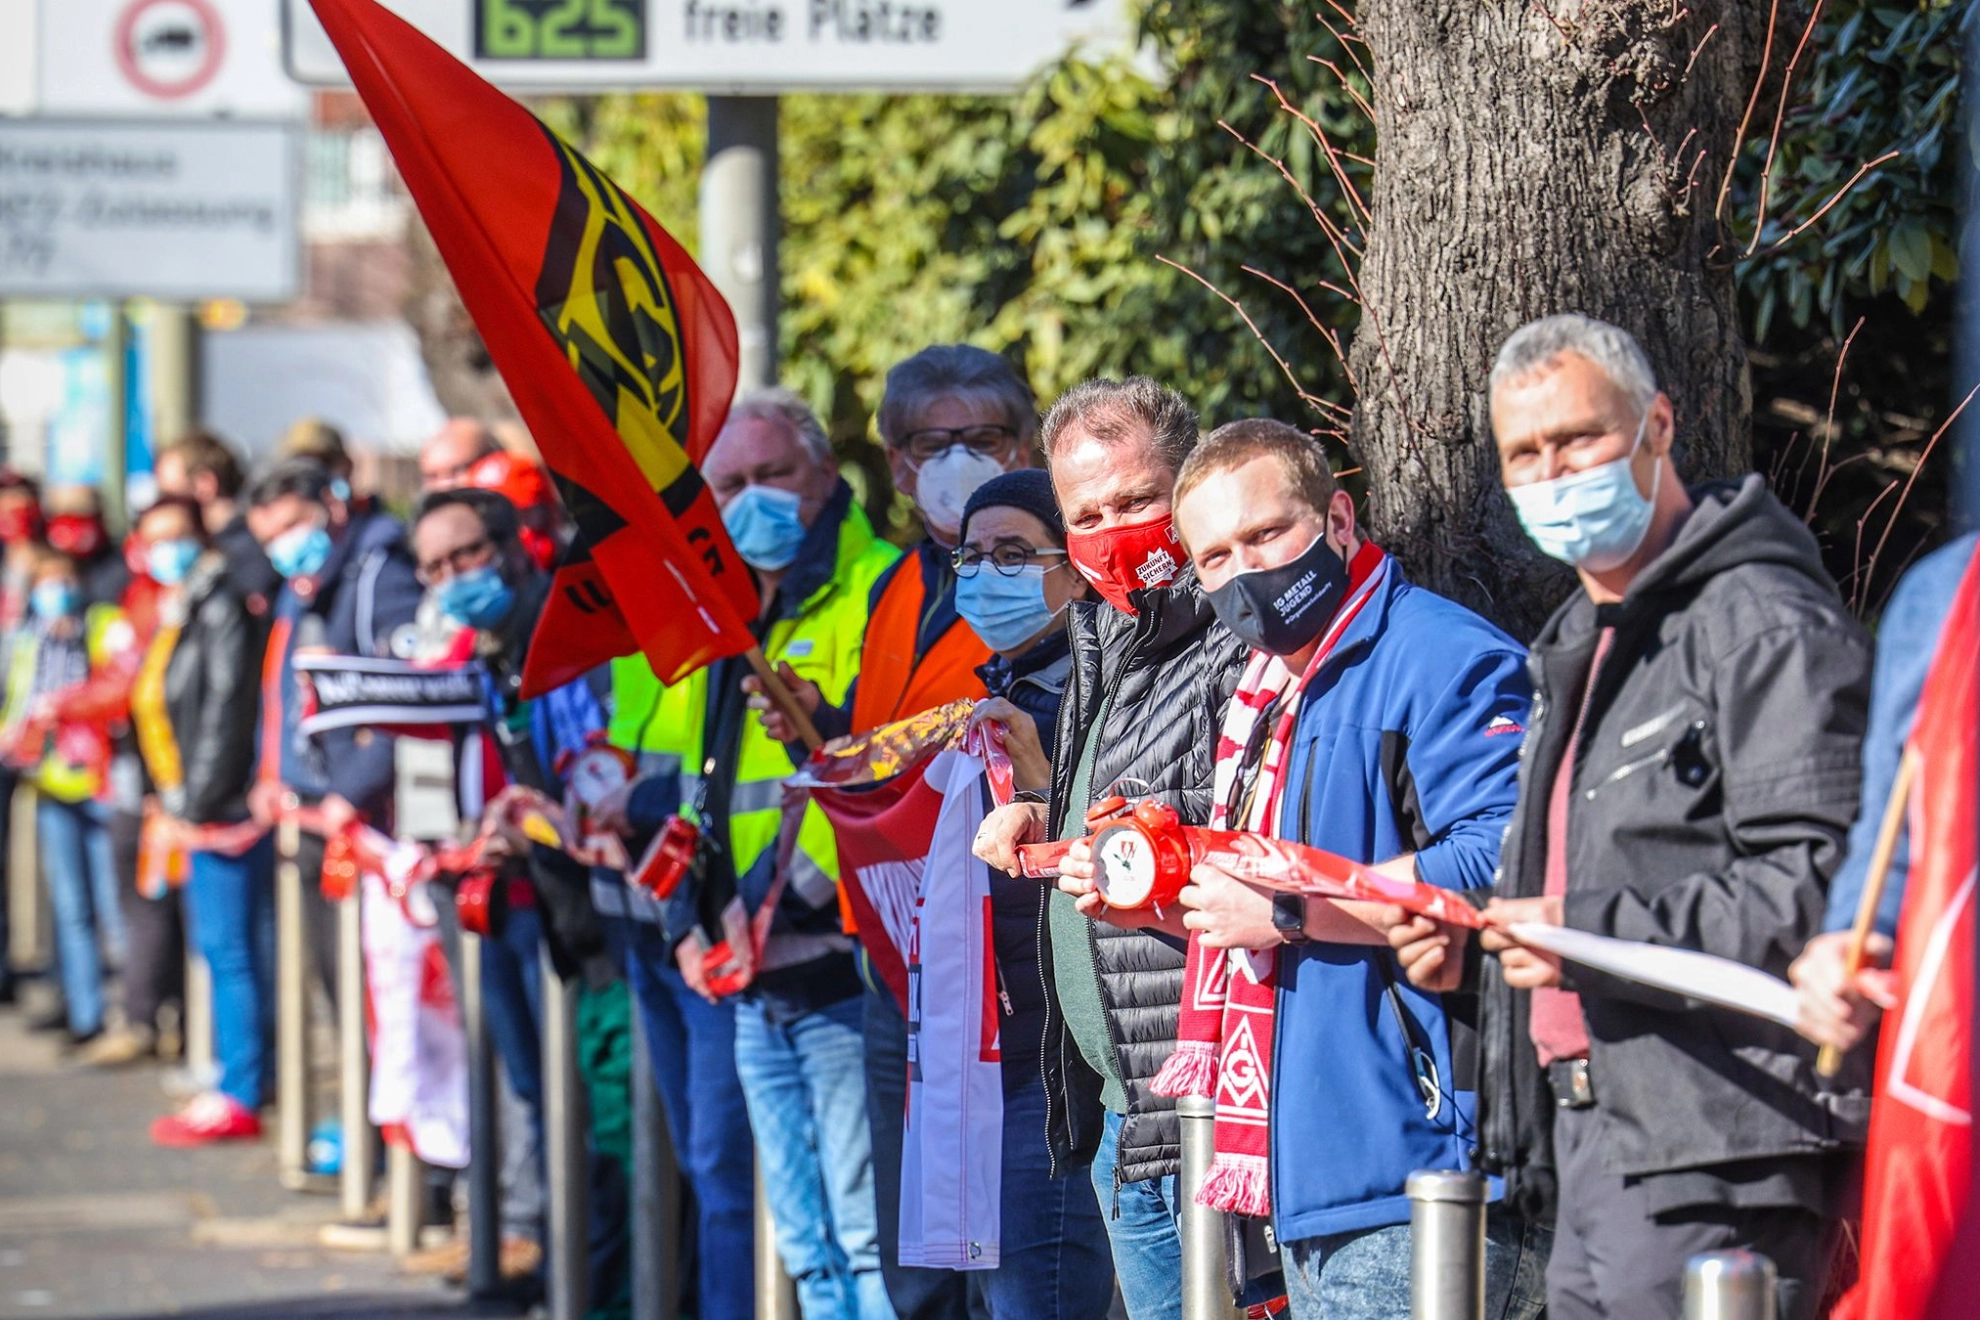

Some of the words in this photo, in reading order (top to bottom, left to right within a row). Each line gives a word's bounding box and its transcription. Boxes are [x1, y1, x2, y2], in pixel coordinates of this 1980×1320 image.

[684, 0, 785, 42] freie
[1137, 552, 1168, 576] ZUKUNFT
[1273, 597, 1285, 611] IG
[1284, 570, 1317, 602] METALL
[1280, 585, 1312, 617] JUGEND
